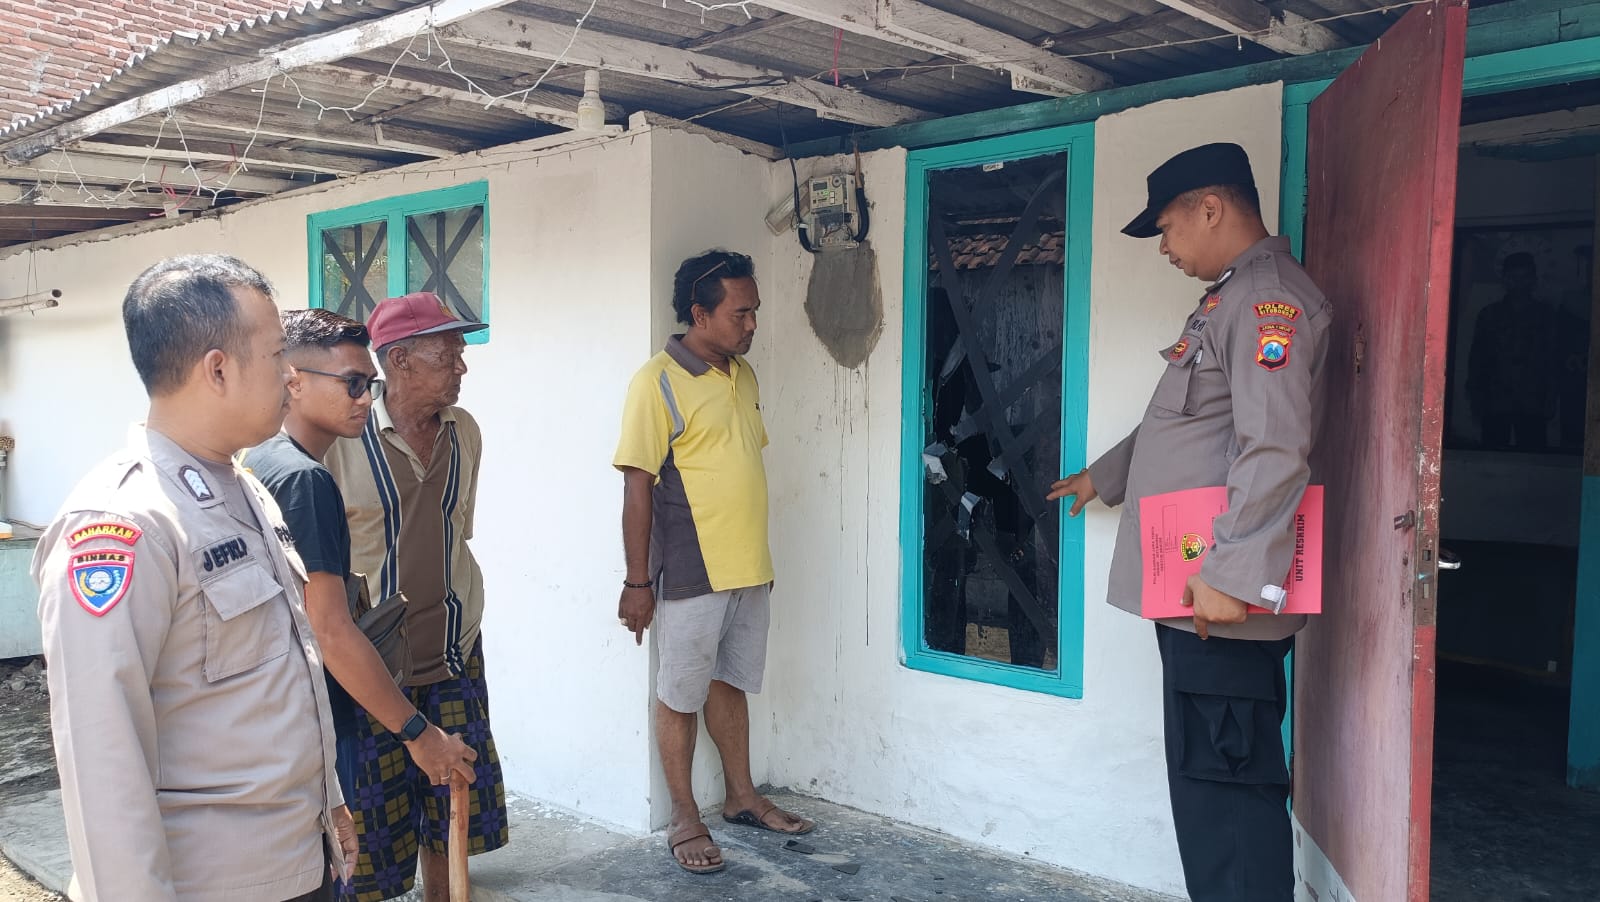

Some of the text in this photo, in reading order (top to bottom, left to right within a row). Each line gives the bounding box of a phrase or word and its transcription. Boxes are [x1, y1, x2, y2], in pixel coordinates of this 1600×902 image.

[1258, 304, 1295, 314] POLRES
[73, 526, 133, 541] BAHARKAM
[1296, 514, 1305, 582] UNIT RESKRIM
[77, 554, 125, 563] BINMAS
